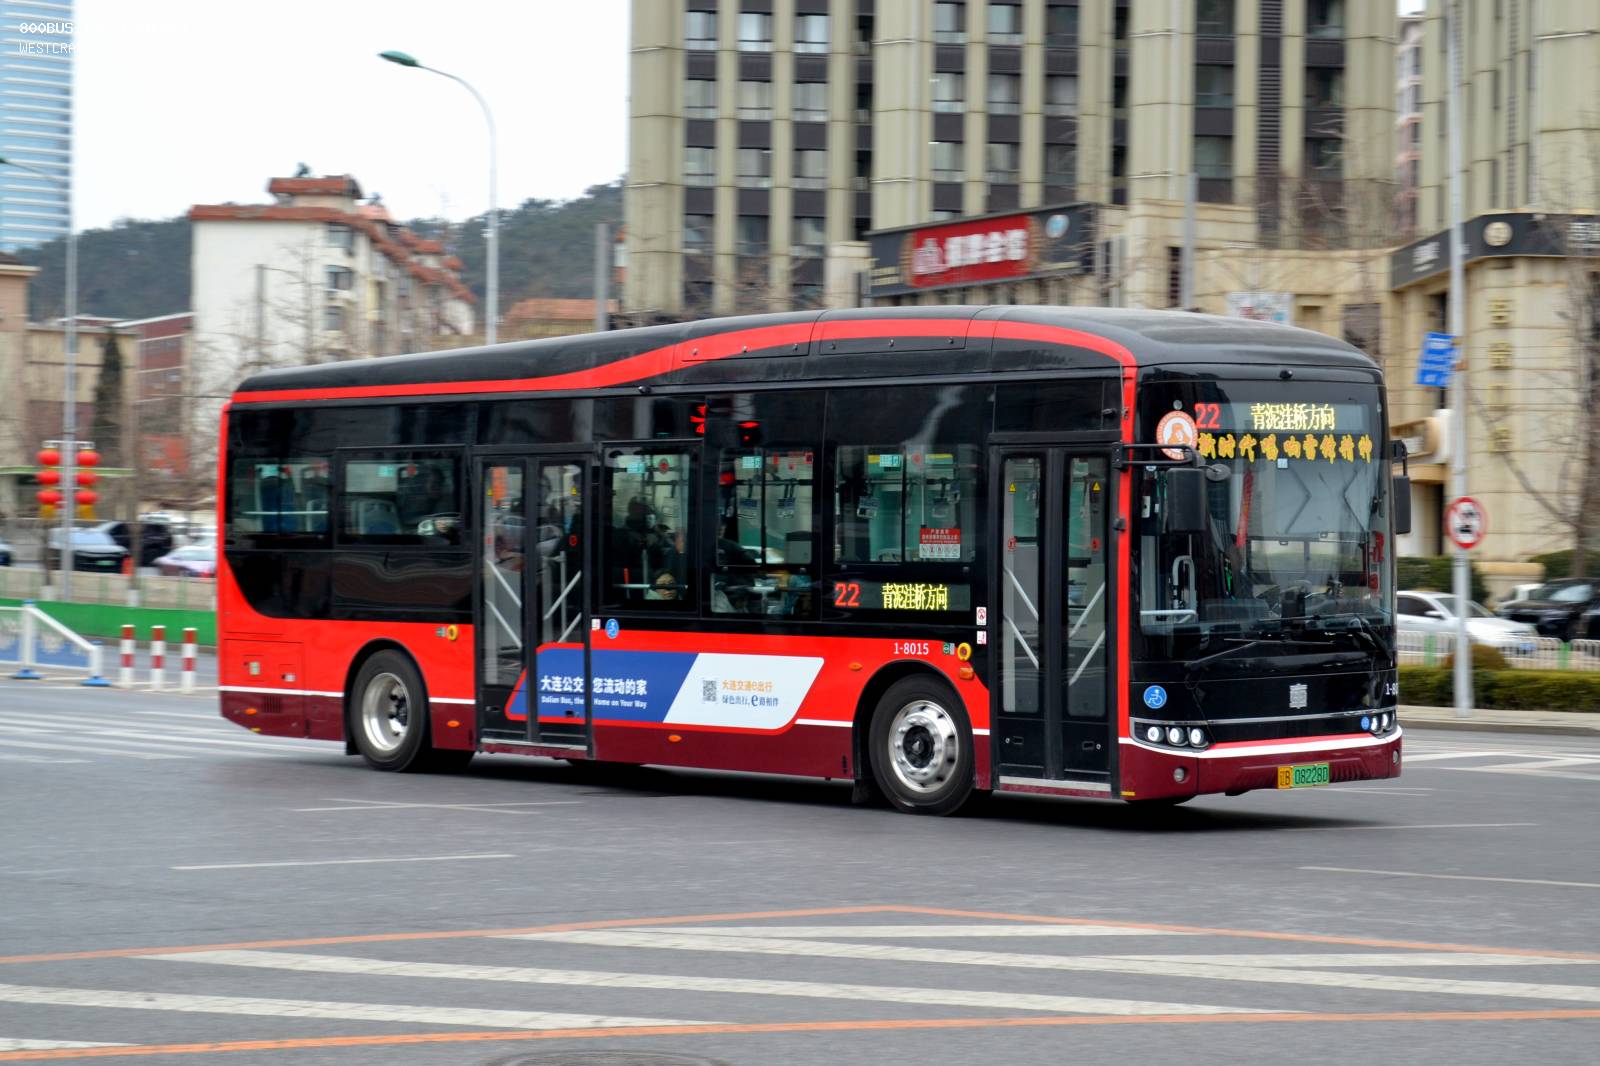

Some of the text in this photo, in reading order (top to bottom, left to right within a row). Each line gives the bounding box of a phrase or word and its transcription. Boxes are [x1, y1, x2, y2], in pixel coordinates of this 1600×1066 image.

[1194, 402, 1336, 431] 22 青泥洼桥方向
[834, 582, 948, 611] 22 青泥洼桥方向
[893, 642, 929, 655] 1-8015
[540, 675, 648, 696] 大连公交 您流动的家
[593, 698, 610, 706] Home
[620, 699, 633, 708] Your
[634, 700, 648, 709] Way
